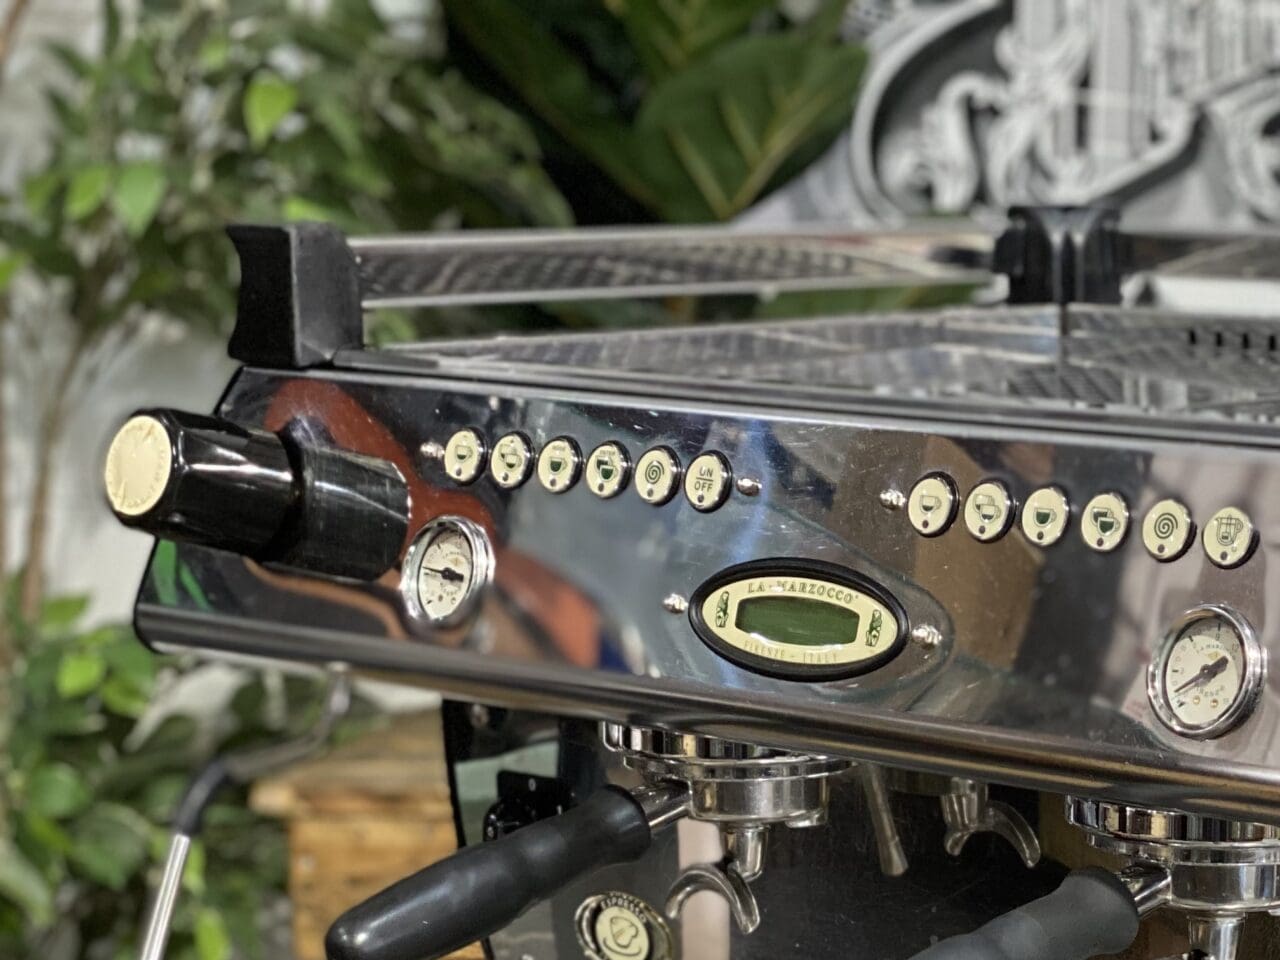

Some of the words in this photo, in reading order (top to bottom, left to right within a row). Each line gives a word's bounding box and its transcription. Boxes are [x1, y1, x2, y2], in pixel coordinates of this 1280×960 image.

[699, 466, 714, 478] ON
[694, 481, 713, 492] OFF
[748, 583, 766, 593] LA
[776, 580, 852, 604] MARZOCCO
[601, 897, 647, 923] ESPRESSO
